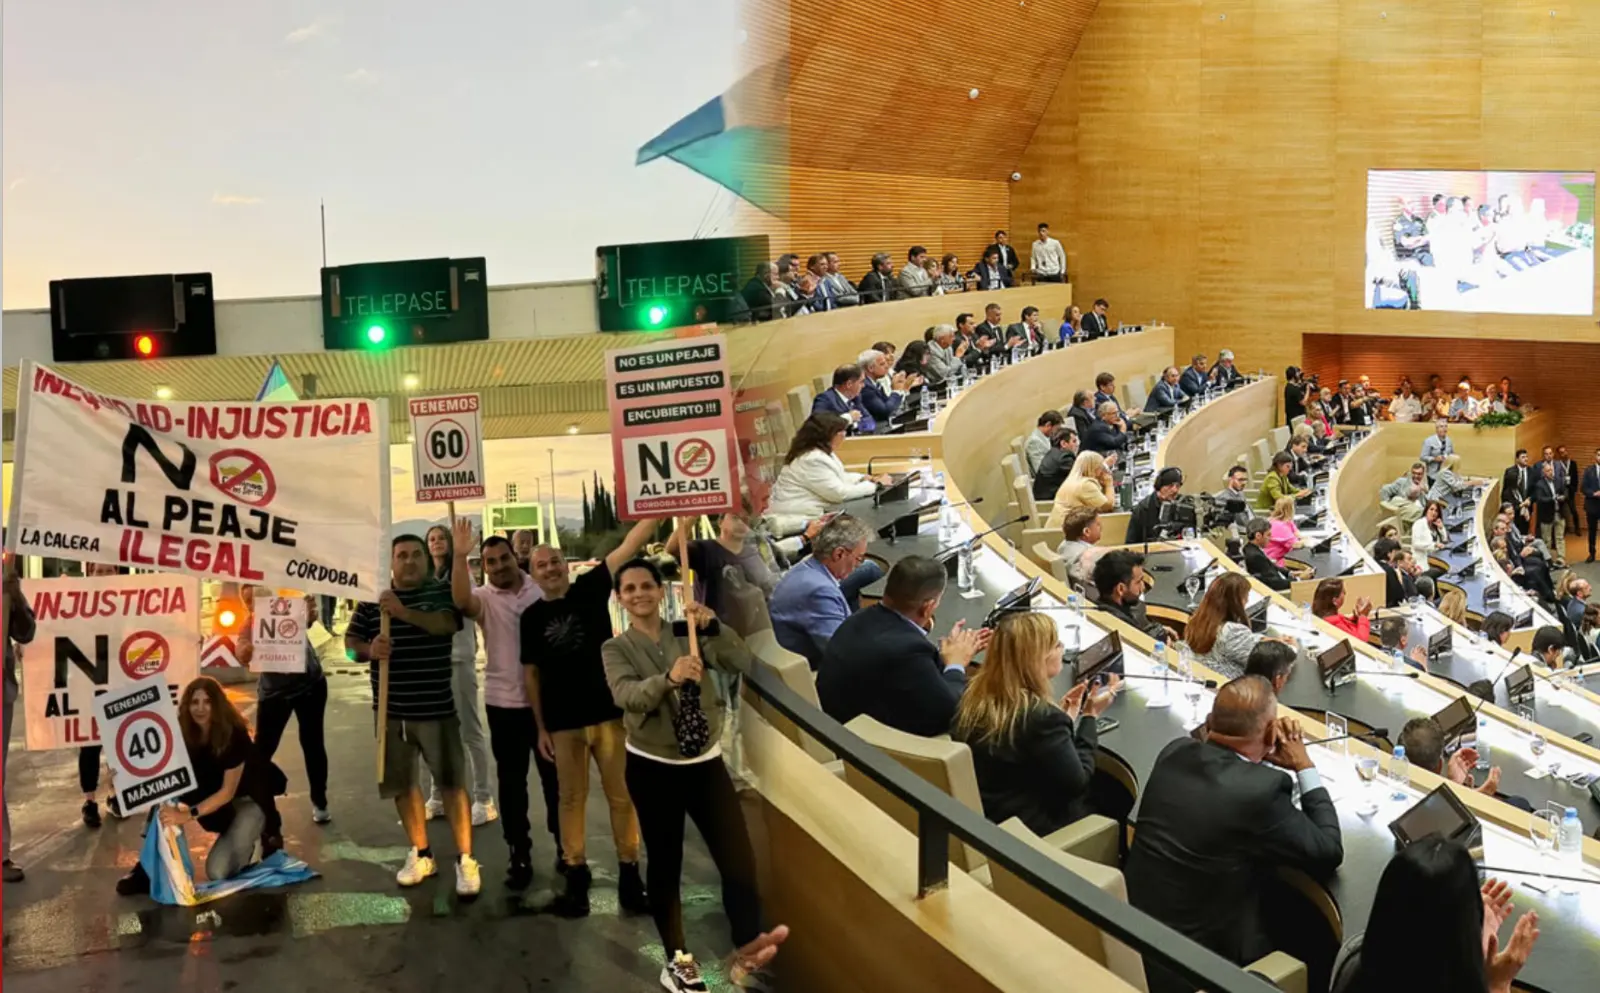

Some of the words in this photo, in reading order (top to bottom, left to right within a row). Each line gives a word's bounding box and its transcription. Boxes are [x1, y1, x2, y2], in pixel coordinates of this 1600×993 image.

[625, 272, 733, 299] TELEPASE
[344, 290, 447, 316] TELEPASE
[619, 358, 637, 368] NO
[639, 355, 654, 366] ES
[656, 352, 674, 363] UN
[676, 347, 716, 361] PEAJE
[619, 384, 636, 395] ES
[637, 381, 655, 393] UN
[657, 374, 720, 391] IMPUESTO
[411, 397, 477, 414] TENEMOS
[627, 406, 704, 422] ENCUBIERTO
[430, 428, 463, 460] 60
[423, 470, 476, 487] MAXIMA
[639, 482, 662, 497] AL
[664, 477, 721, 494] PEAJE
[419, 490, 433, 500] ES
[101, 488, 149, 529] AL
[162, 494, 299, 548] PEAJE
[20, 527, 41, 546] LA
[43, 531, 100, 552] CALERA
[119, 528, 265, 581] ILEGAL
[286, 558, 359, 588] CÓRDOBA
[34, 586, 187, 621] INJUSTICIA
[45, 692, 79, 718] AL
[107, 689, 155, 716] TENEMOS
[128, 726, 161, 760] 40
